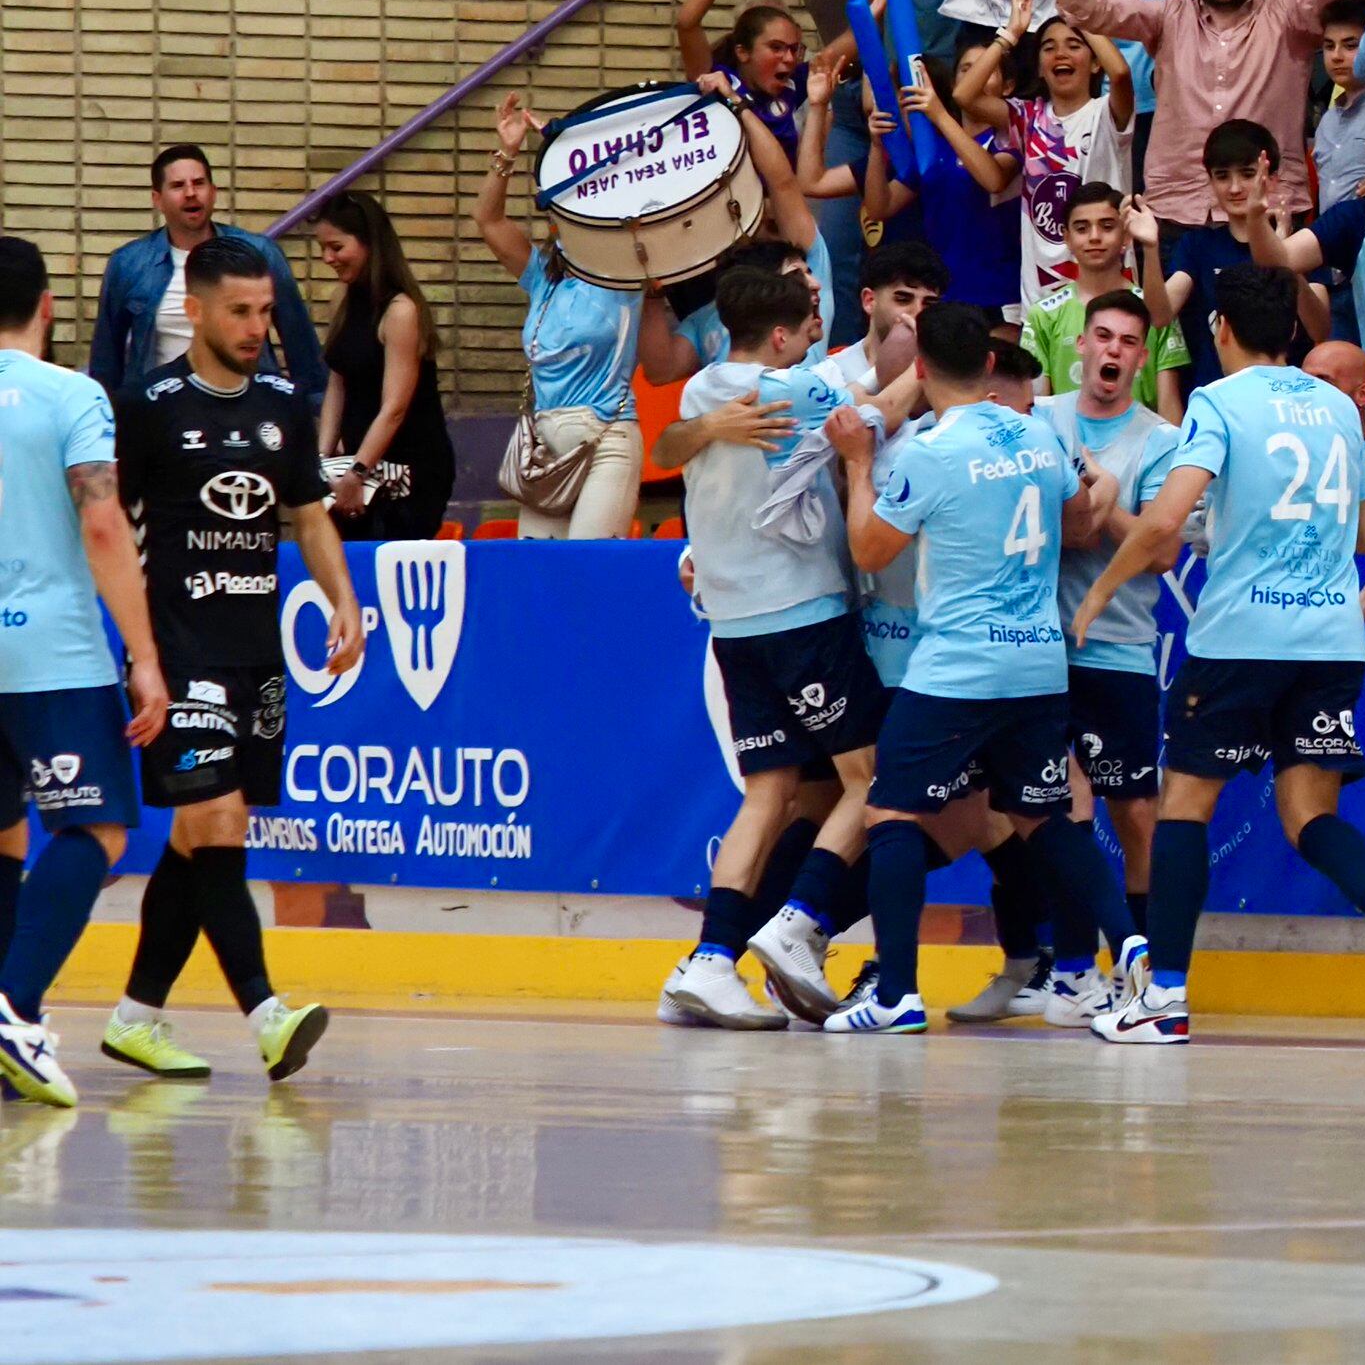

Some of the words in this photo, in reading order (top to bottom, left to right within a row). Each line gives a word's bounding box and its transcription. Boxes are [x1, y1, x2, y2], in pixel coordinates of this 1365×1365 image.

[674, 111, 710, 144] EL
[626, 159, 667, 184] REAL
[672, 144, 718, 171] PEÑA
[576, 173, 619, 199] JAÉN
[1268, 399, 1333, 426] Titín
[968, 457, 1018, 484] Fede
[1015, 447, 1058, 475] Día
[1266, 432, 1351, 524] 24
[1003, 484, 1047, 566] 4
[283, 743, 530, 808] CORAUTO
[244, 815, 317, 851] CAMBIOS
[326, 812, 406, 855] ORTEGA
[415, 812, 532, 858] AUTOMOCIÓN
